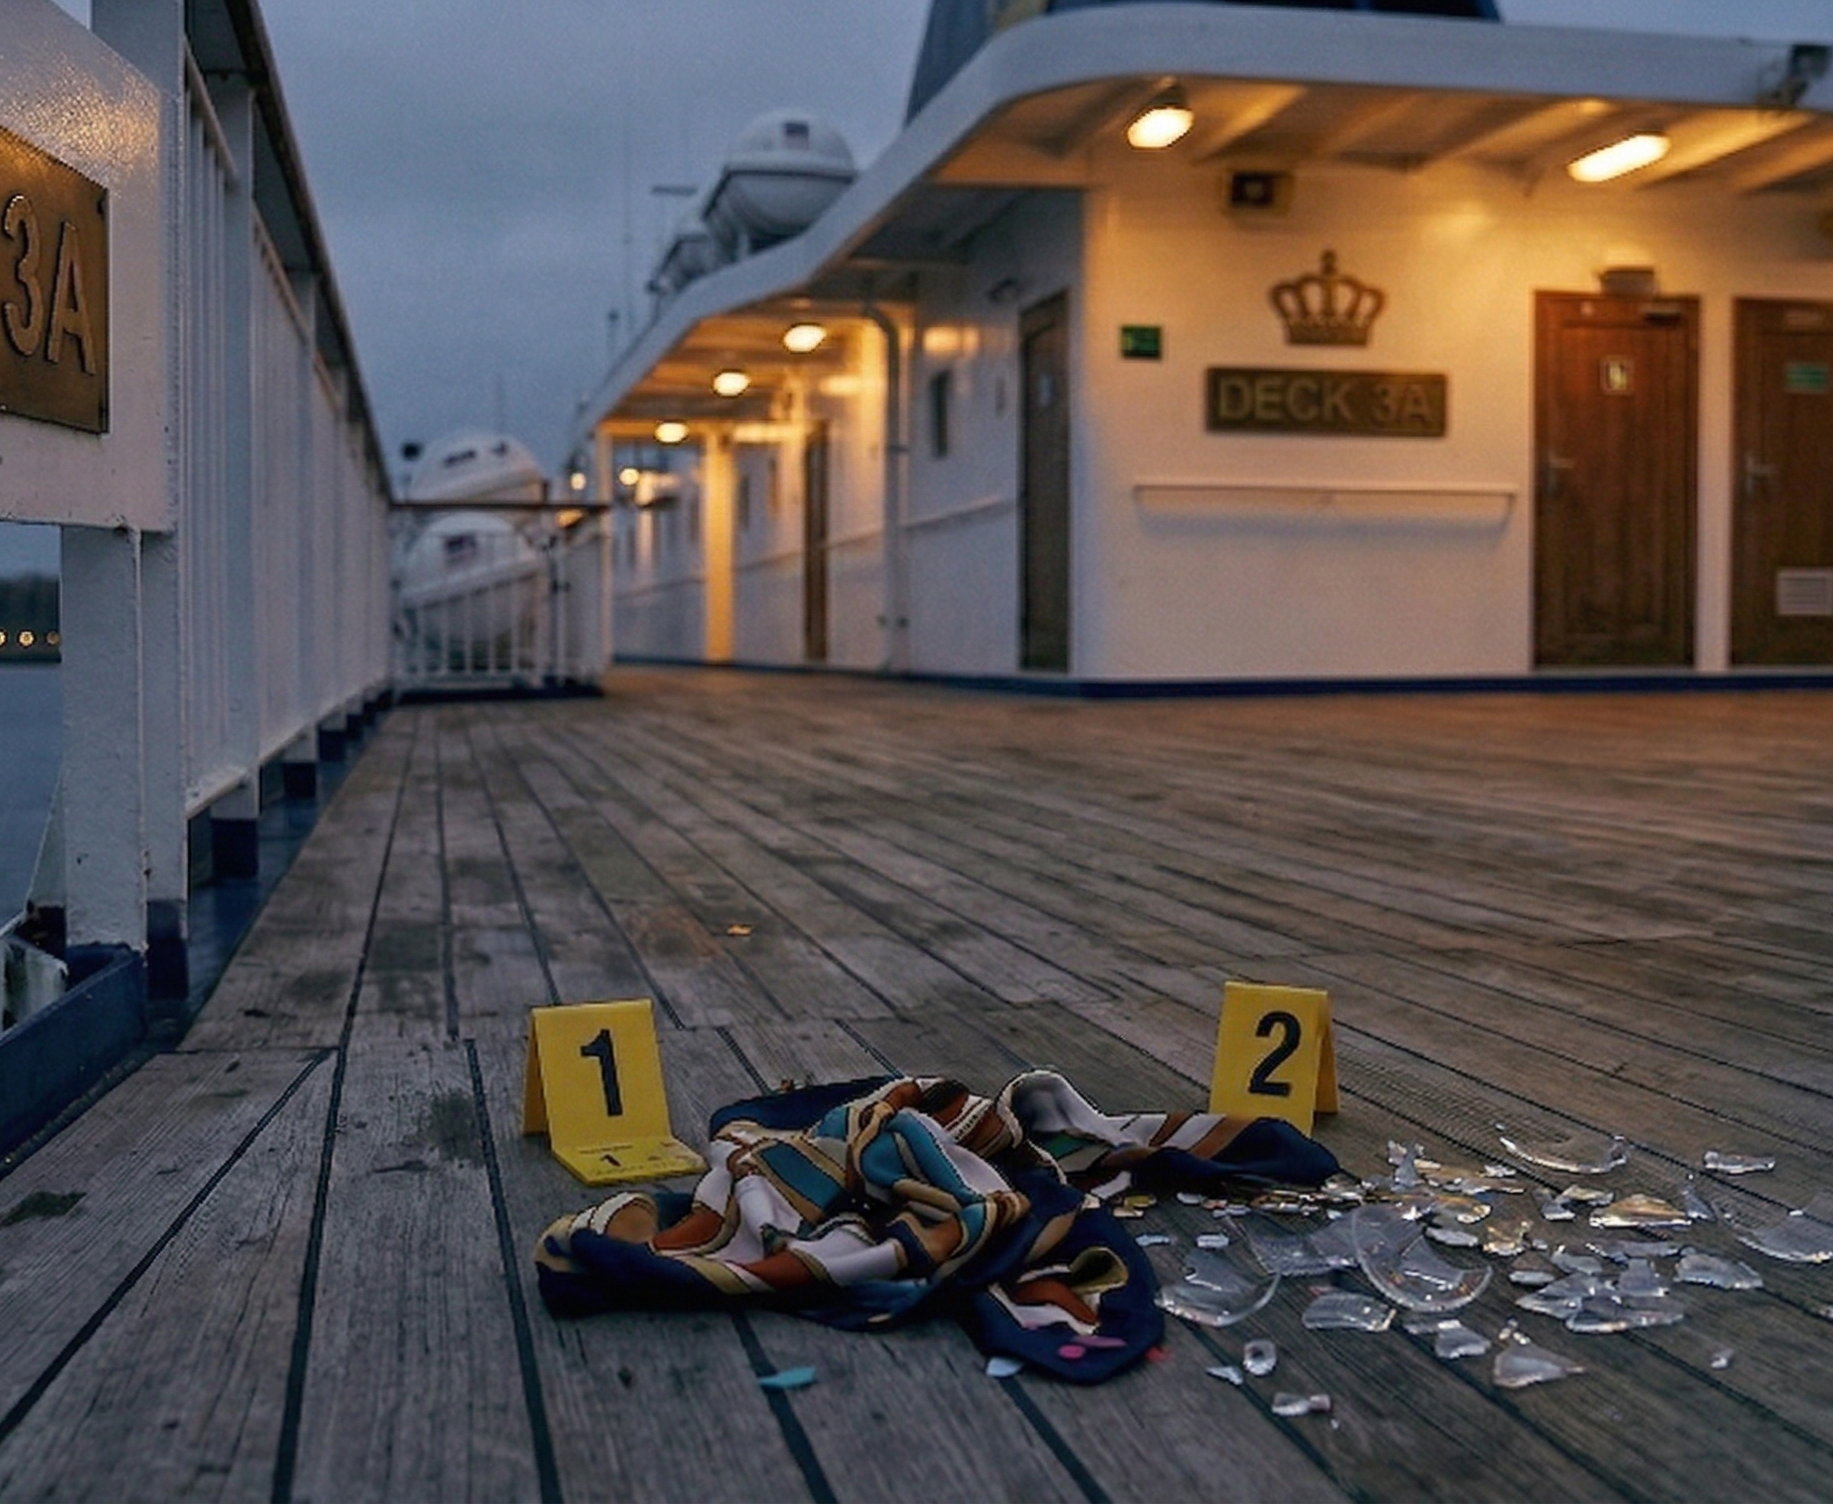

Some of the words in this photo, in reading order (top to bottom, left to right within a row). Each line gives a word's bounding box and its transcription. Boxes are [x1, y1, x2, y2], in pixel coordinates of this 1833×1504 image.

[4, 194, 96, 376] 3A
[1217, 375, 1354, 422] DECK
[1371, 382, 1432, 424] 3A
[580, 1029, 623, 1116] 1
[1249, 1011, 1301, 1096] 2
